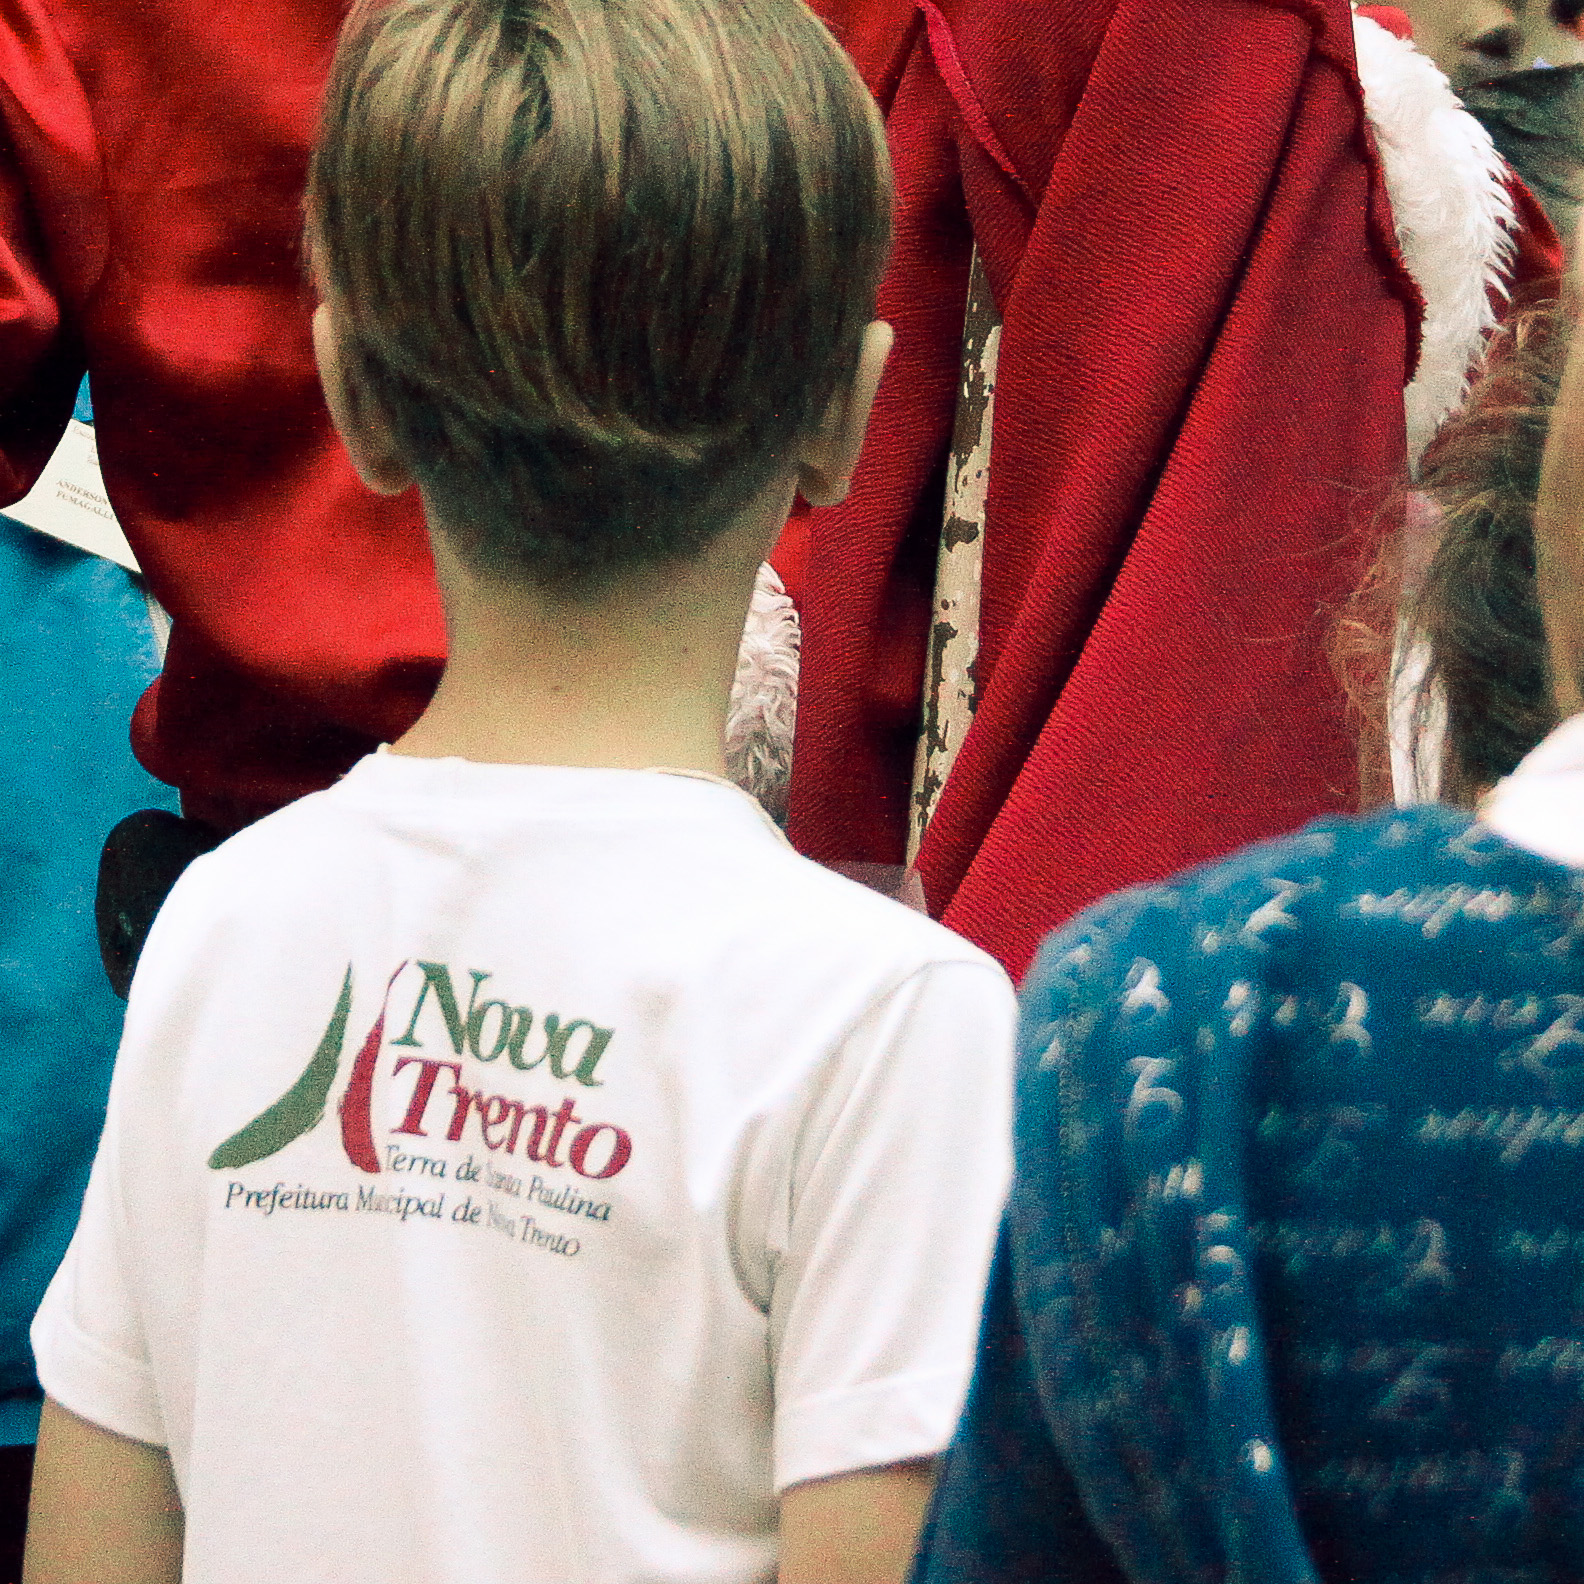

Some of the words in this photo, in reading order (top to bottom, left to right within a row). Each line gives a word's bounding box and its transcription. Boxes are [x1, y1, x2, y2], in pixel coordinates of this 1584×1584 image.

[56, 480, 107, 506] ANDERSON
[390, 960, 615, 1087] Nova
[390, 1056, 632, 1179] Trento
[225, 1181, 348, 1216] Prefeitura
[452, 1196, 482, 1224] de
[520, 1215, 581, 1257] Trento
[385, 1144, 446, 1178] Terra
[455, 1155, 481, 1183] de
[528, 1175, 612, 1221] Paulina
